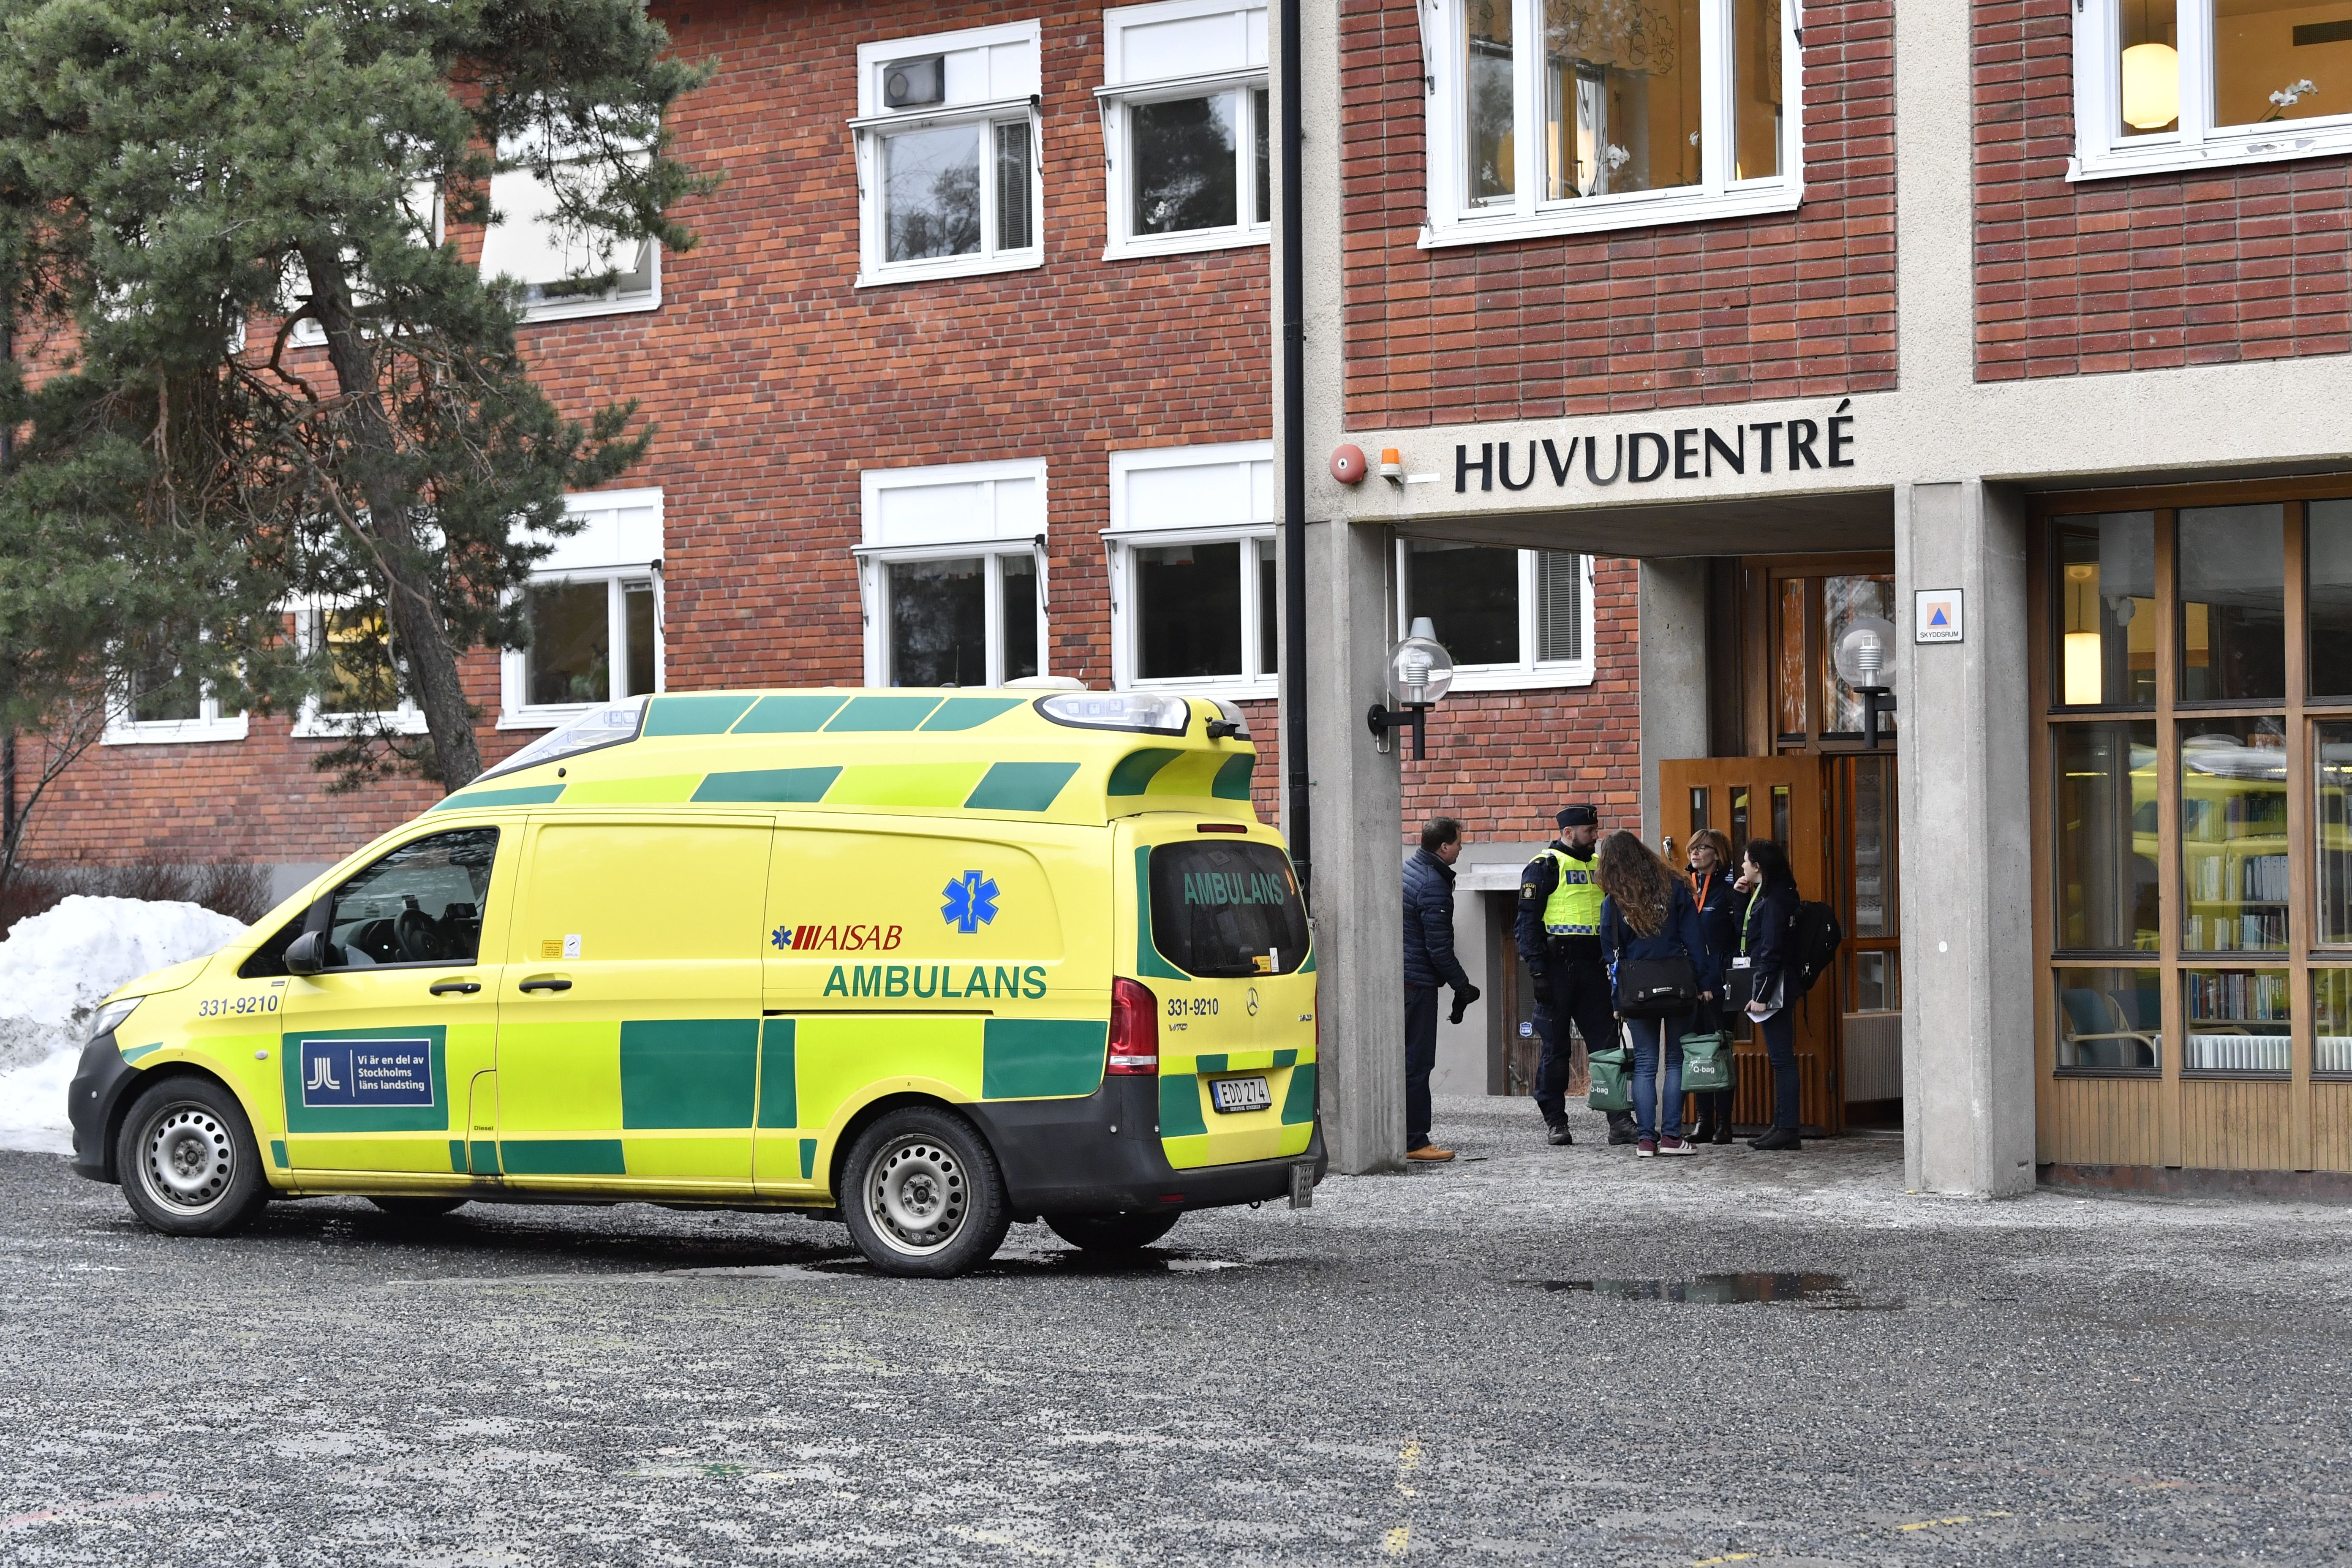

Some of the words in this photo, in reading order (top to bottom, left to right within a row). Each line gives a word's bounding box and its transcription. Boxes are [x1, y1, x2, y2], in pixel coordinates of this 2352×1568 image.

[1455, 398, 1854, 493] HUVUDENTRÉ
[1184, 872, 1284, 905] AMBULANS
[816, 925, 902, 950] AISAB
[823, 965, 1047, 999] AMBULANS
[199, 995, 278, 1017] 331-9210
[1168, 998, 1219, 1016] 331-9210
[357, 1055, 367, 1064] Vi
[369, 1055, 379, 1064] är
[395, 1054, 411, 1064] del
[358, 1067, 412, 1077] Stockholms
[1693, 1066, 1715, 1074] Q-bag
[359, 1080, 378, 1089] läns
[381, 1080, 425, 1092] landsting
[1221, 1083, 1242, 1104] EDD
[1244, 1081, 1265, 1102] 274
[1590, 1086, 1609, 1095] Q-bag
